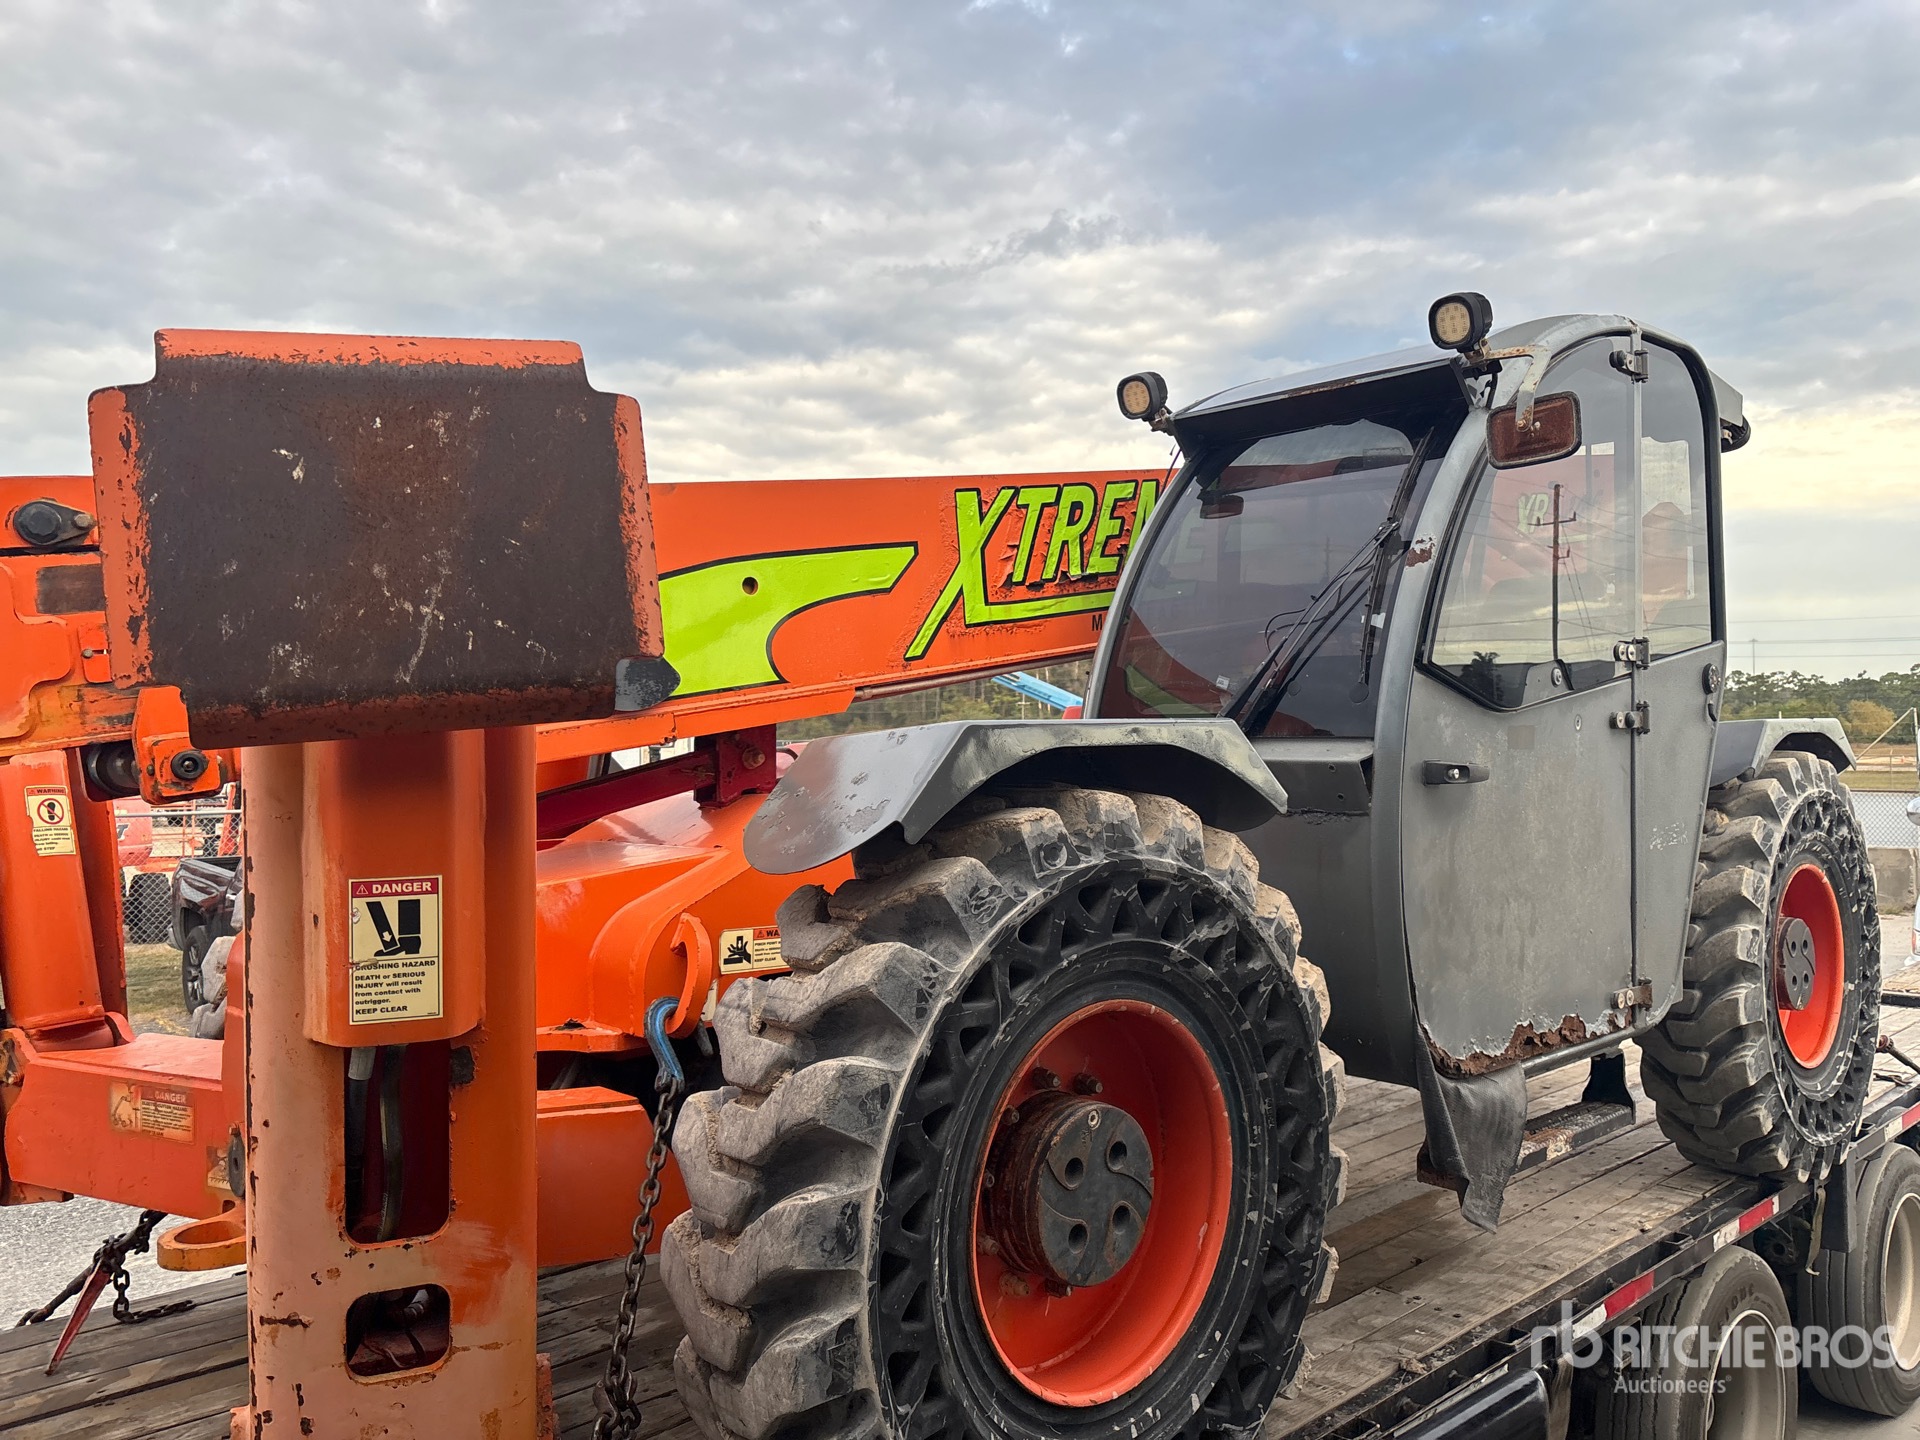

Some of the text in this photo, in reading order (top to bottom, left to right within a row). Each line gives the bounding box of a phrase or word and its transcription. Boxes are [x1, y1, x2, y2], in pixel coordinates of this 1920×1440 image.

[372, 881, 433, 894] DANGER
[402, 960, 436, 968] HAZARD
[392, 971, 426, 979] SERIOUS
[374, 988, 403, 996] contact
[355, 998, 391, 1006] outrigger.
[380, 1005, 408, 1013] CLEAR
